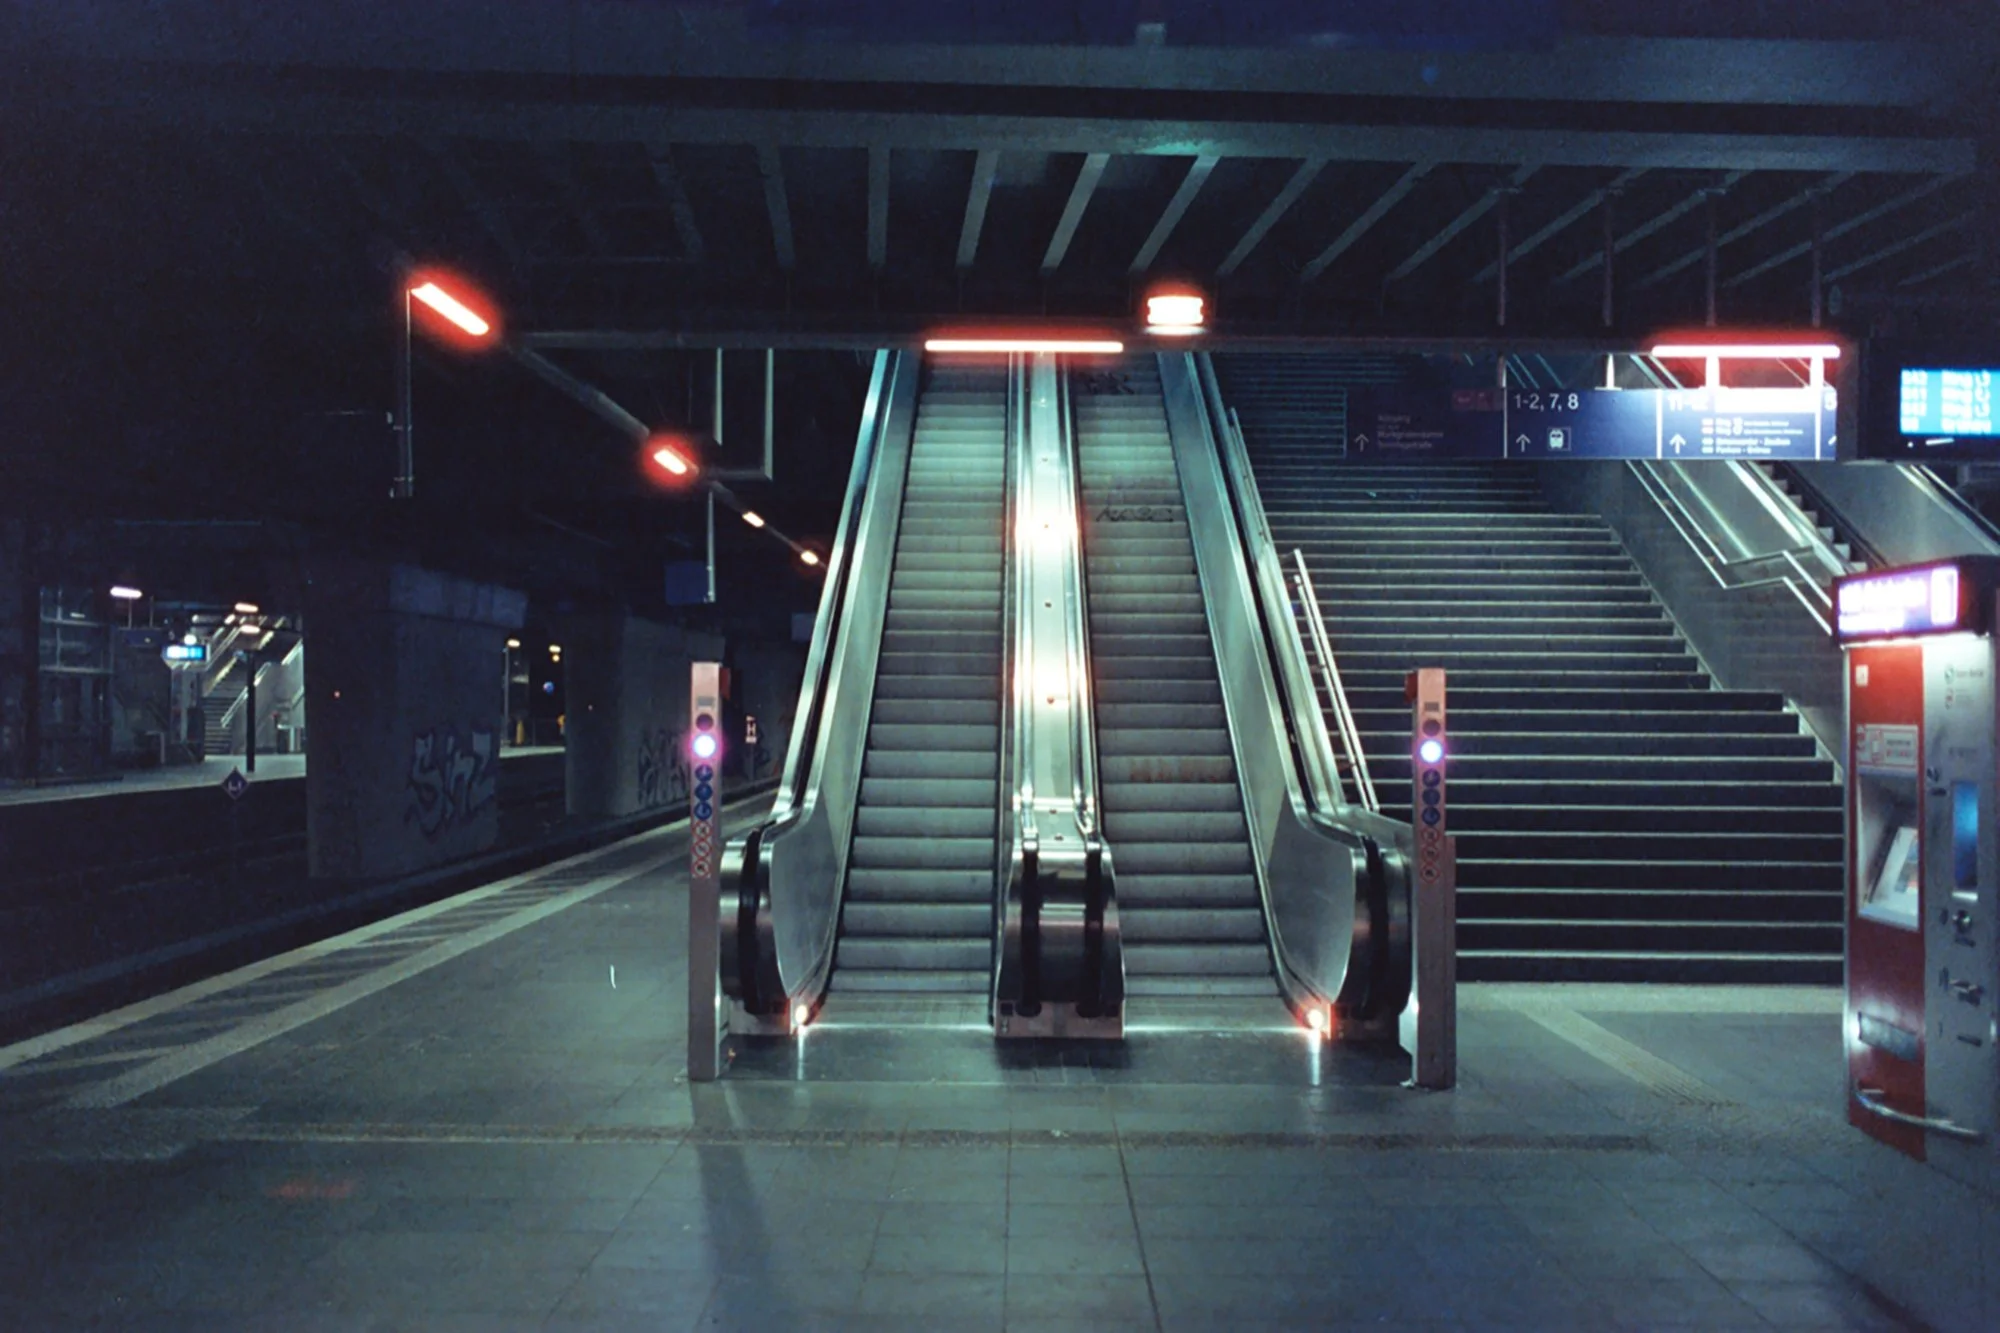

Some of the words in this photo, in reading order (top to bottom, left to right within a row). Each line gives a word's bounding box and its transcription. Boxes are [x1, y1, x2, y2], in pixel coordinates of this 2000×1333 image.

[1514, 393, 1545, 412] 1-2,
[1549, 393, 1562, 412] 7,
[1568, 393, 1579, 410] 8
